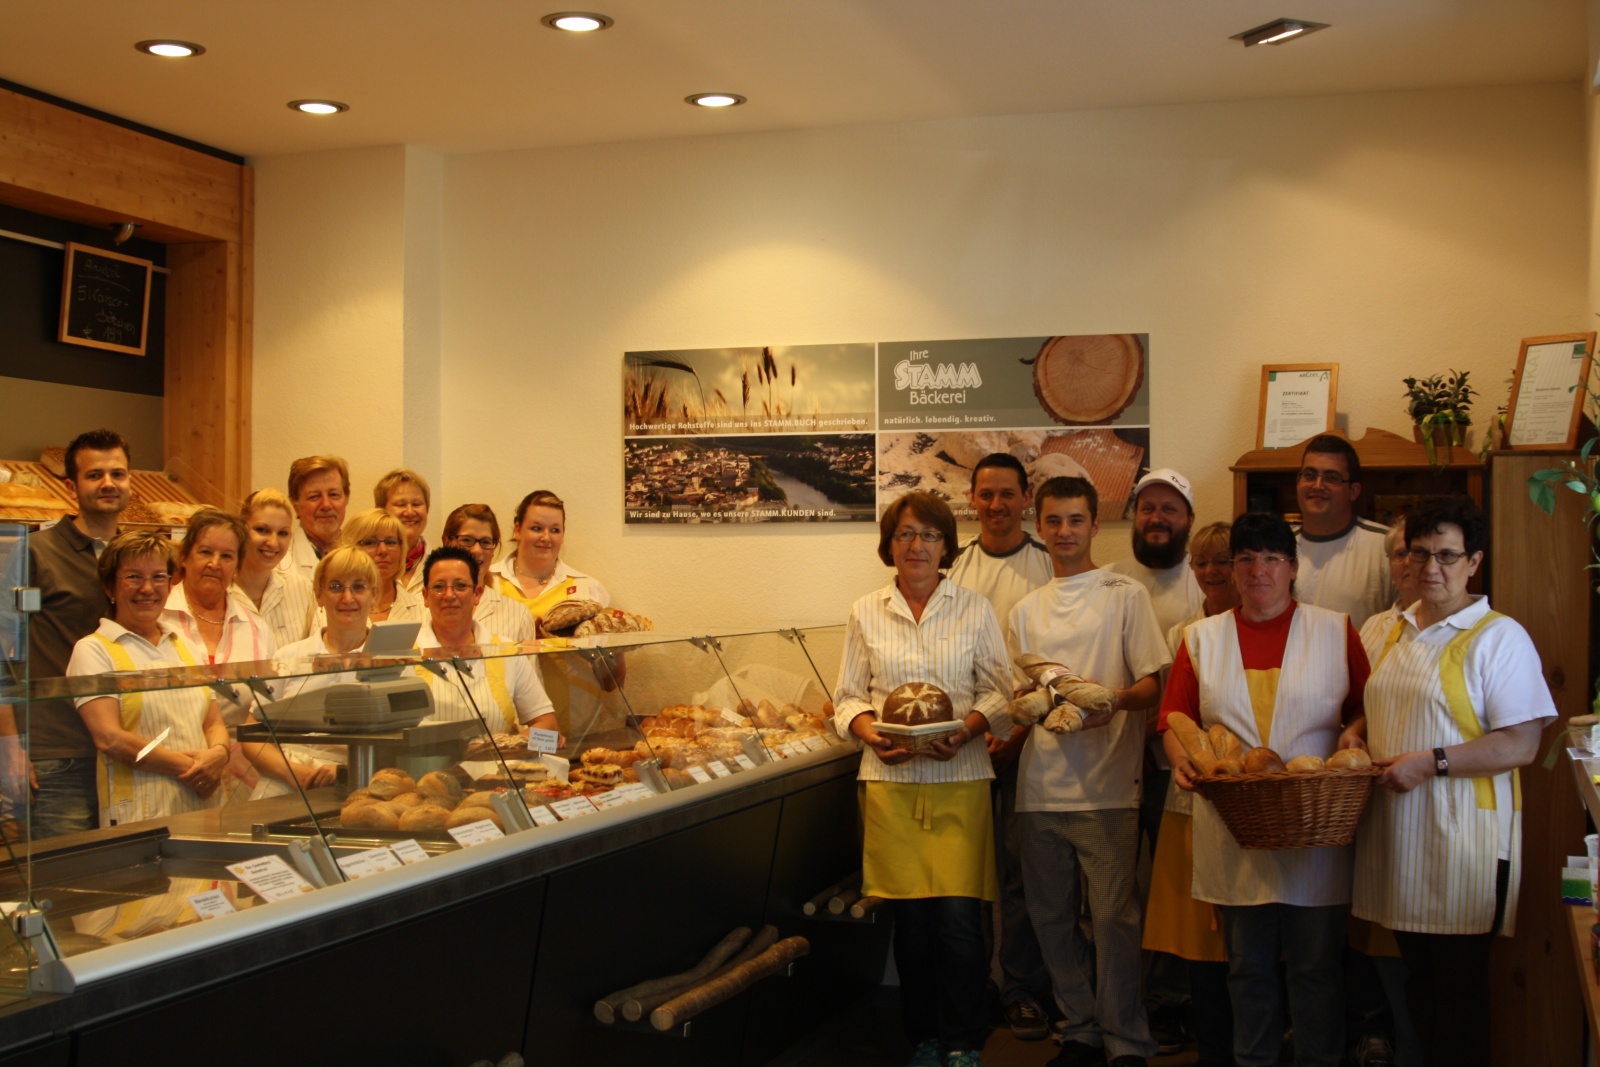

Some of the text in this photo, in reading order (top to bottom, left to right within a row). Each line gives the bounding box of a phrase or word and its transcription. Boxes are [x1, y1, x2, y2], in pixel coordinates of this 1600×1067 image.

[909, 349, 929, 361] Ihre
[893, 359, 983, 391] STAMM
[909, 390, 966, 405] Bäckerei
[1509, 349, 1542, 442] ZERTIFIKAT
[629, 417, 868, 431] Hochwertige Rohstoffe sind uns ins STAMM.BUCH geschrieben.
[884, 414, 997, 425] natürlich. lebendig. kreativ.
[644, 510, 661, 518] sind
[672, 510, 699, 519] Hause,
[723, 510, 750, 518] unsere
[751, 509, 815, 517] STAMM.KUNDEN
[817, 508, 837, 517] sind.
